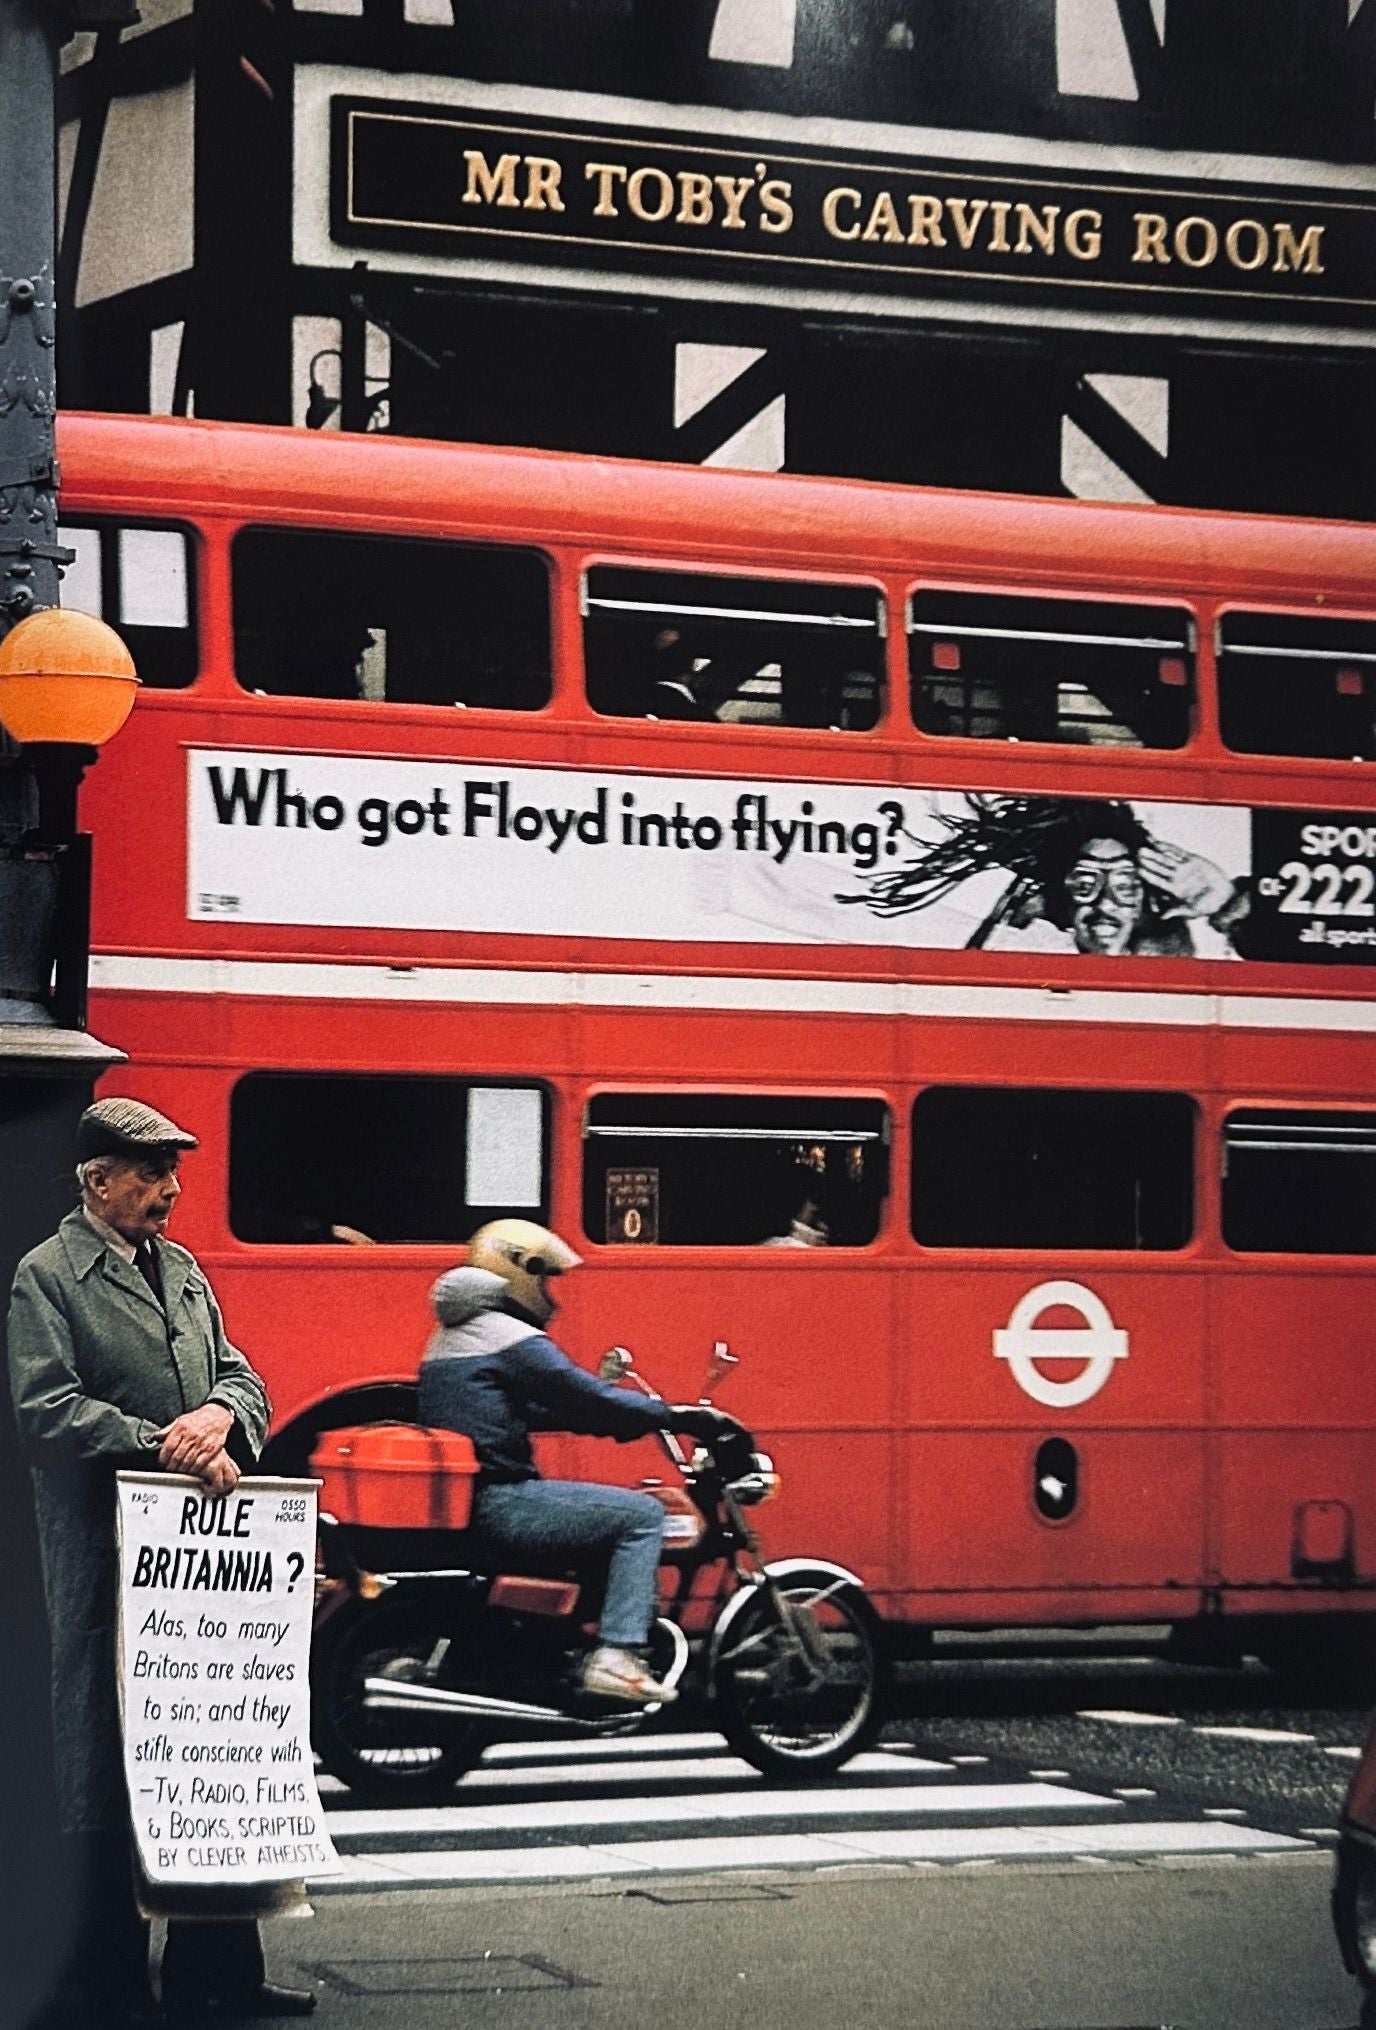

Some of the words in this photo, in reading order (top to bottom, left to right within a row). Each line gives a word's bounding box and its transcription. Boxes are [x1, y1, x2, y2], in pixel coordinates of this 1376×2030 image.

[462, 151, 565, 211] MR
[586, 160, 797, 232] TOBY'S
[822, 187, 1102, 260] CARVING
[1132, 213, 1324, 273] ROOM
[207, 766, 344, 830] Who
[358, 788, 449, 847] got
[464, 781, 608, 853] Floyd
[622, 792, 722, 850] into
[731, 794, 904, 869] flying?
[180, 1495, 254, 1537] RULE
[276, 1512, 304, 1522] HOURS
[132, 1546, 272, 1592] BRITANNIA
[140, 1609, 186, 1639] Alas,
[198, 1614, 226, 1638] too
[238, 1623, 290, 1646] many
[133, 1650, 198, 1679] Britons
[207, 1663, 233, 1679] are
[242, 1654, 295, 1680] slaves
[144, 1696, 161, 1720] to
[171, 1698, 201, 1723] sin;
[209, 1696, 246, 1721] and
[253, 1695, 290, 1729] they
[136, 1734, 173, 1761] stifle
[182, 1740, 262, 1762] conscience
[271, 1737, 301, 1762] with
[239, 1816, 315, 1838] SCRIPTED
[159, 1848, 177, 1867] BY
[188, 1847, 245, 1866] CLEVER
